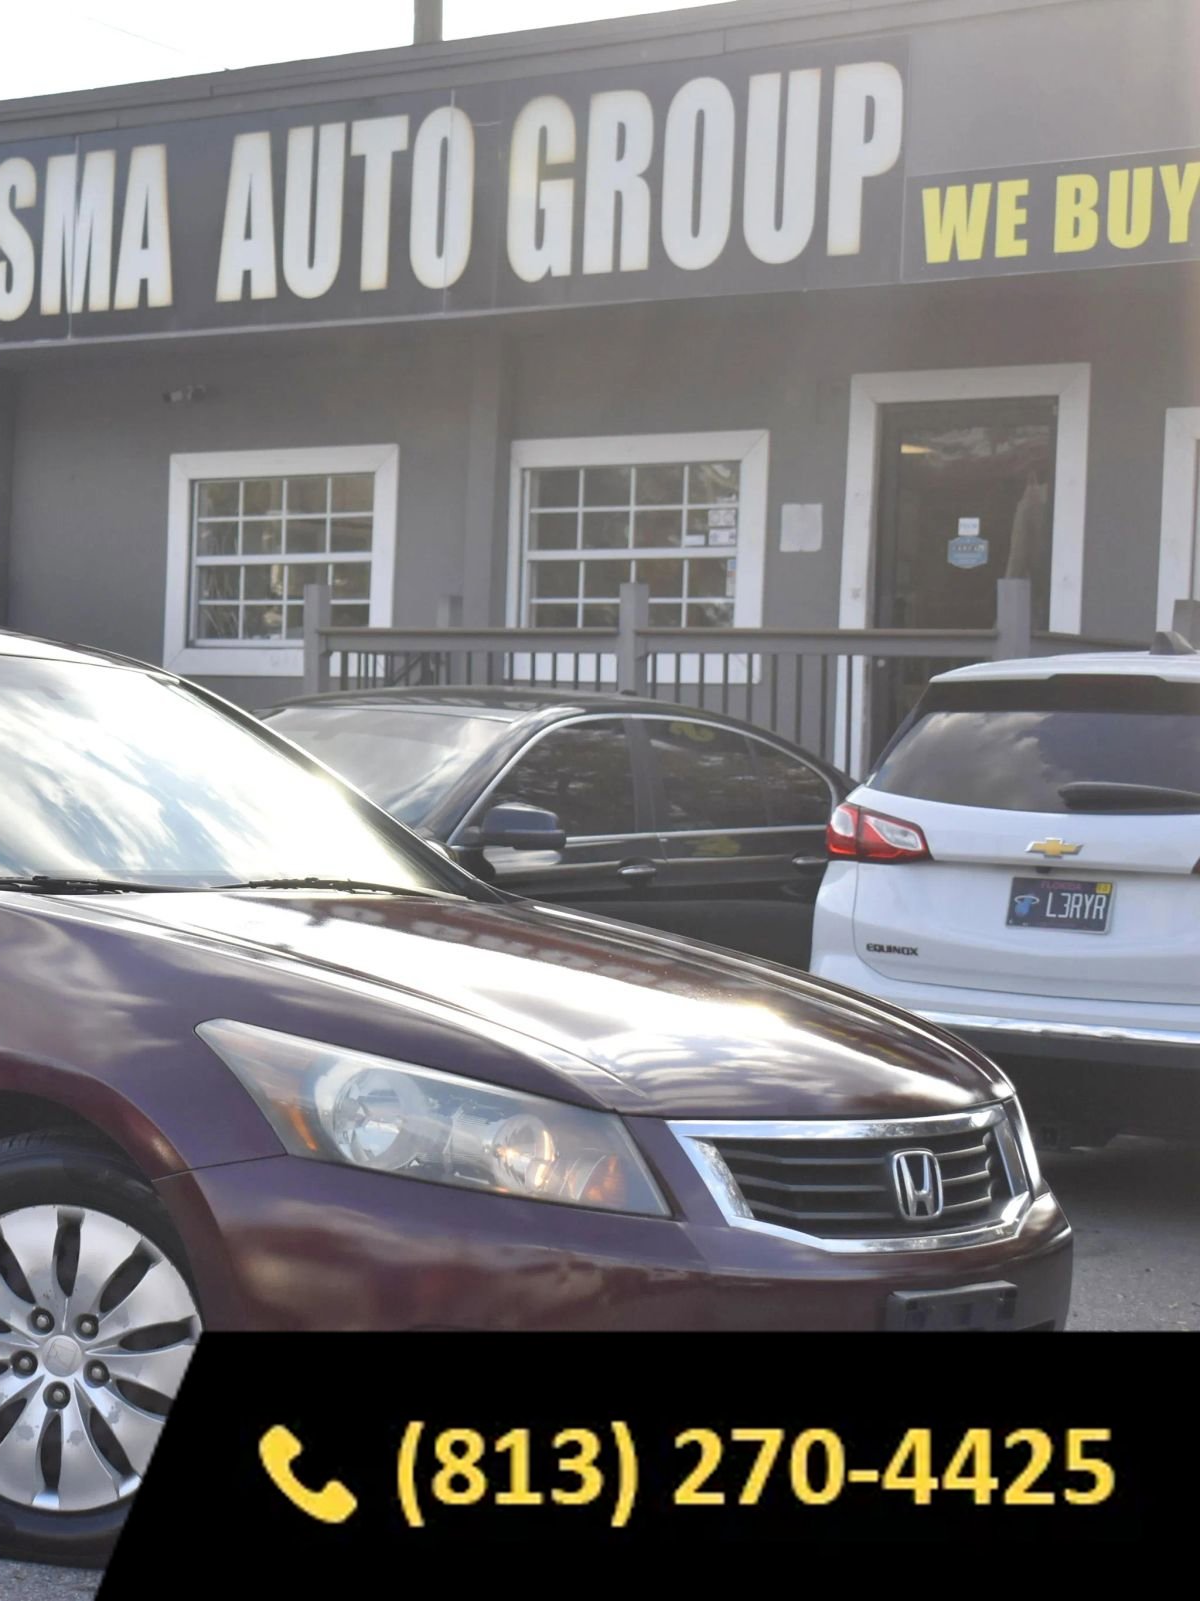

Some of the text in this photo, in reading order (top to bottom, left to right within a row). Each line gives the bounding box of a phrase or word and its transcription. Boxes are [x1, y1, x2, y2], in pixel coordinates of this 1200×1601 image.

[216, 106, 475, 302] AUTO
[506, 61, 902, 283] GROUP
[922, 161, 1200, 264] WE BUY
[866, 943, 919, 957] EQUINOX
